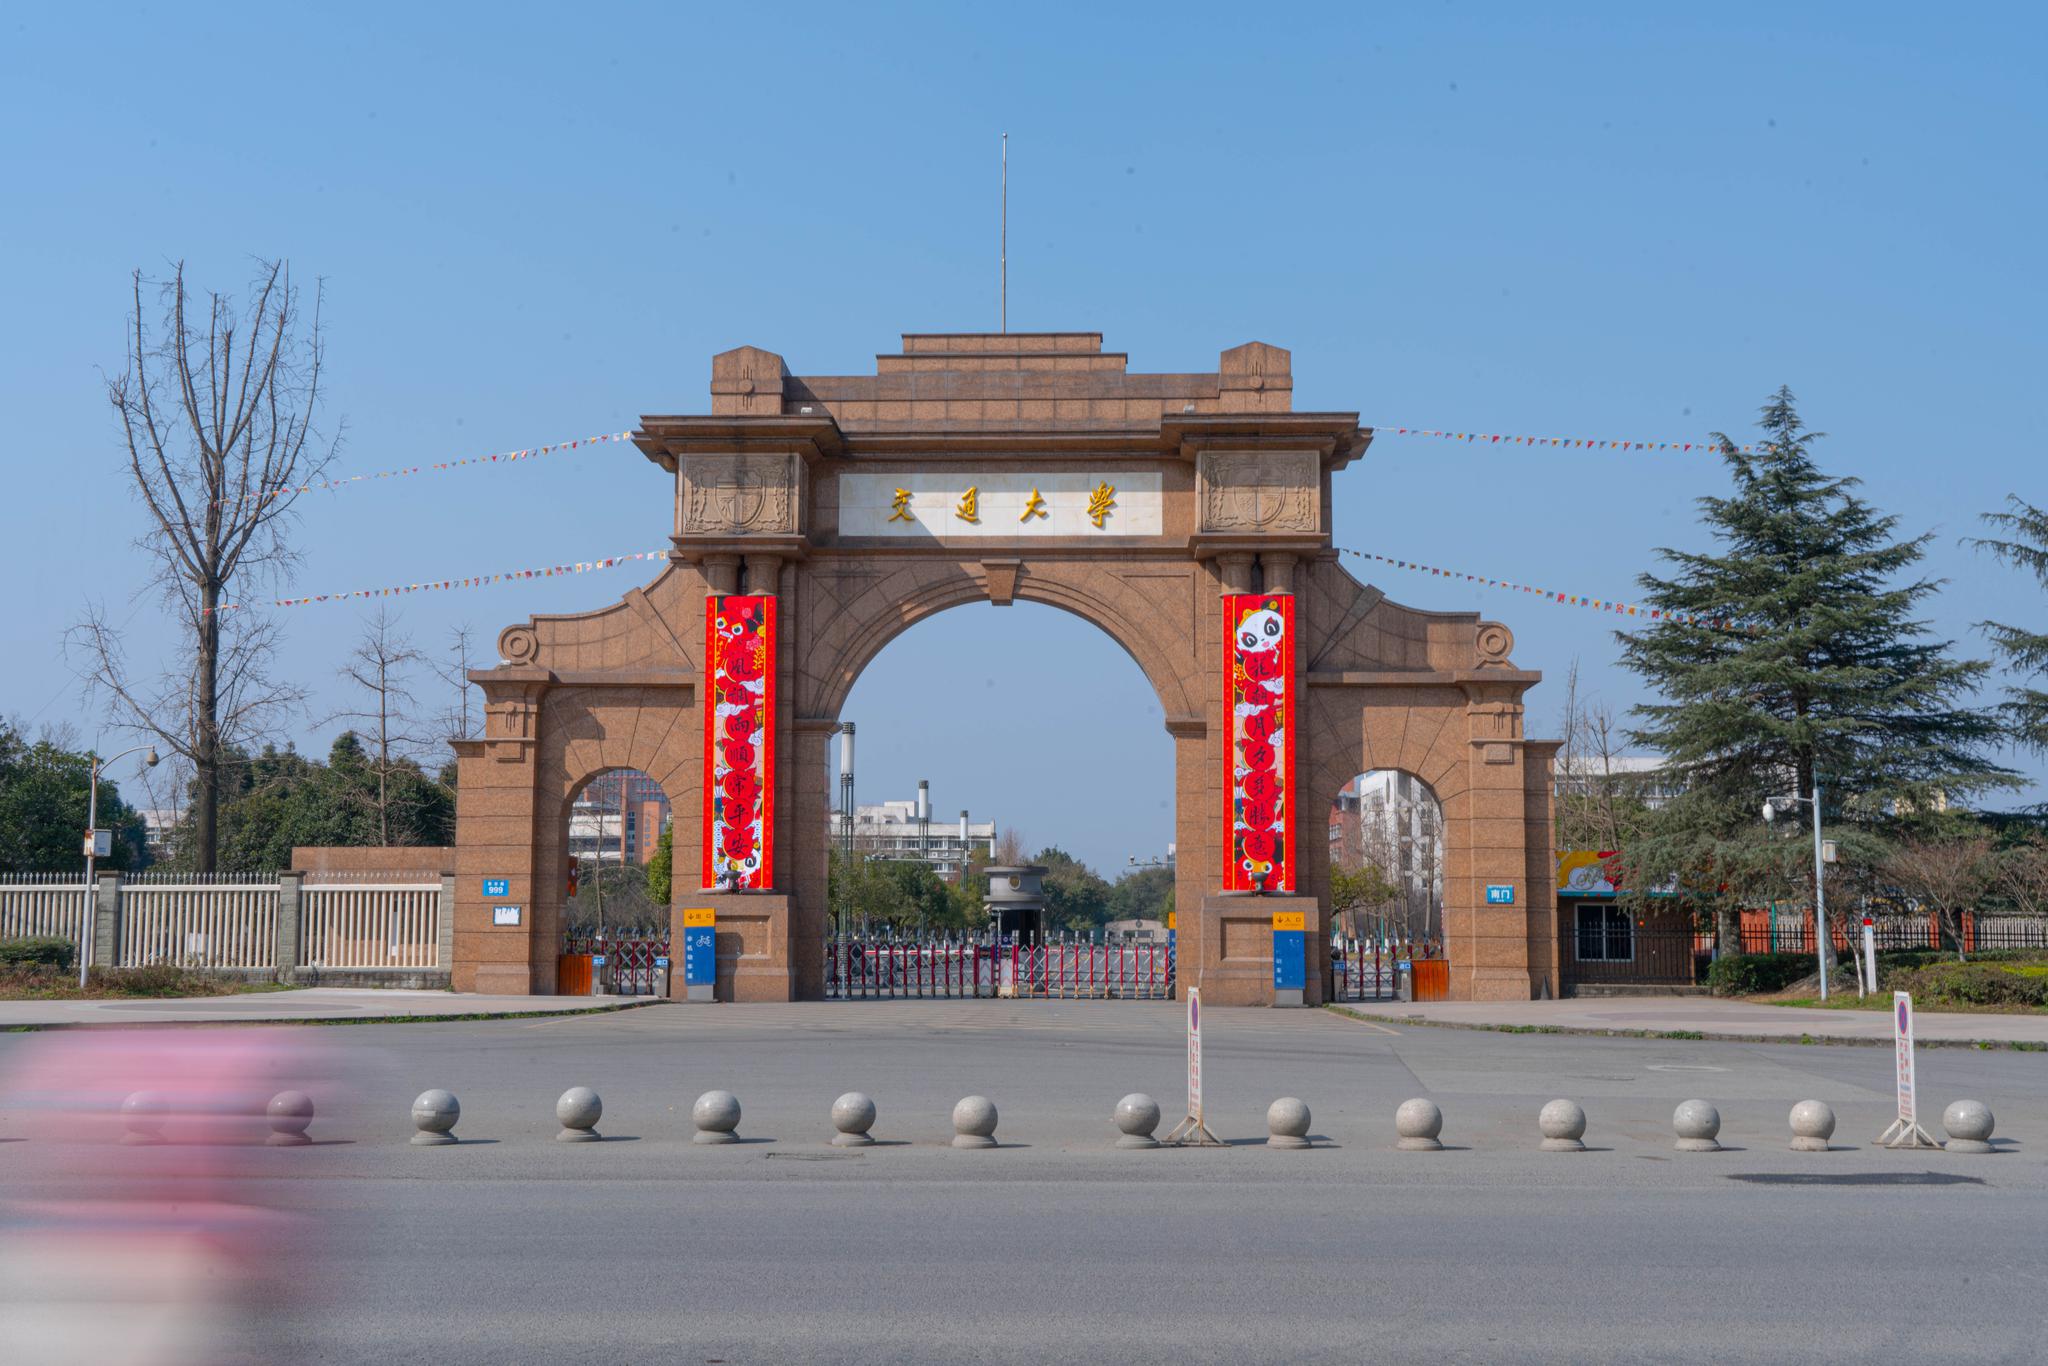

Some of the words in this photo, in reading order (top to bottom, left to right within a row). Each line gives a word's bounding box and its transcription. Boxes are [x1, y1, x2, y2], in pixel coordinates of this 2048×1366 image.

[888, 480, 1116, 528] 交通大學
[1490, 889, 1510, 899] 南门
